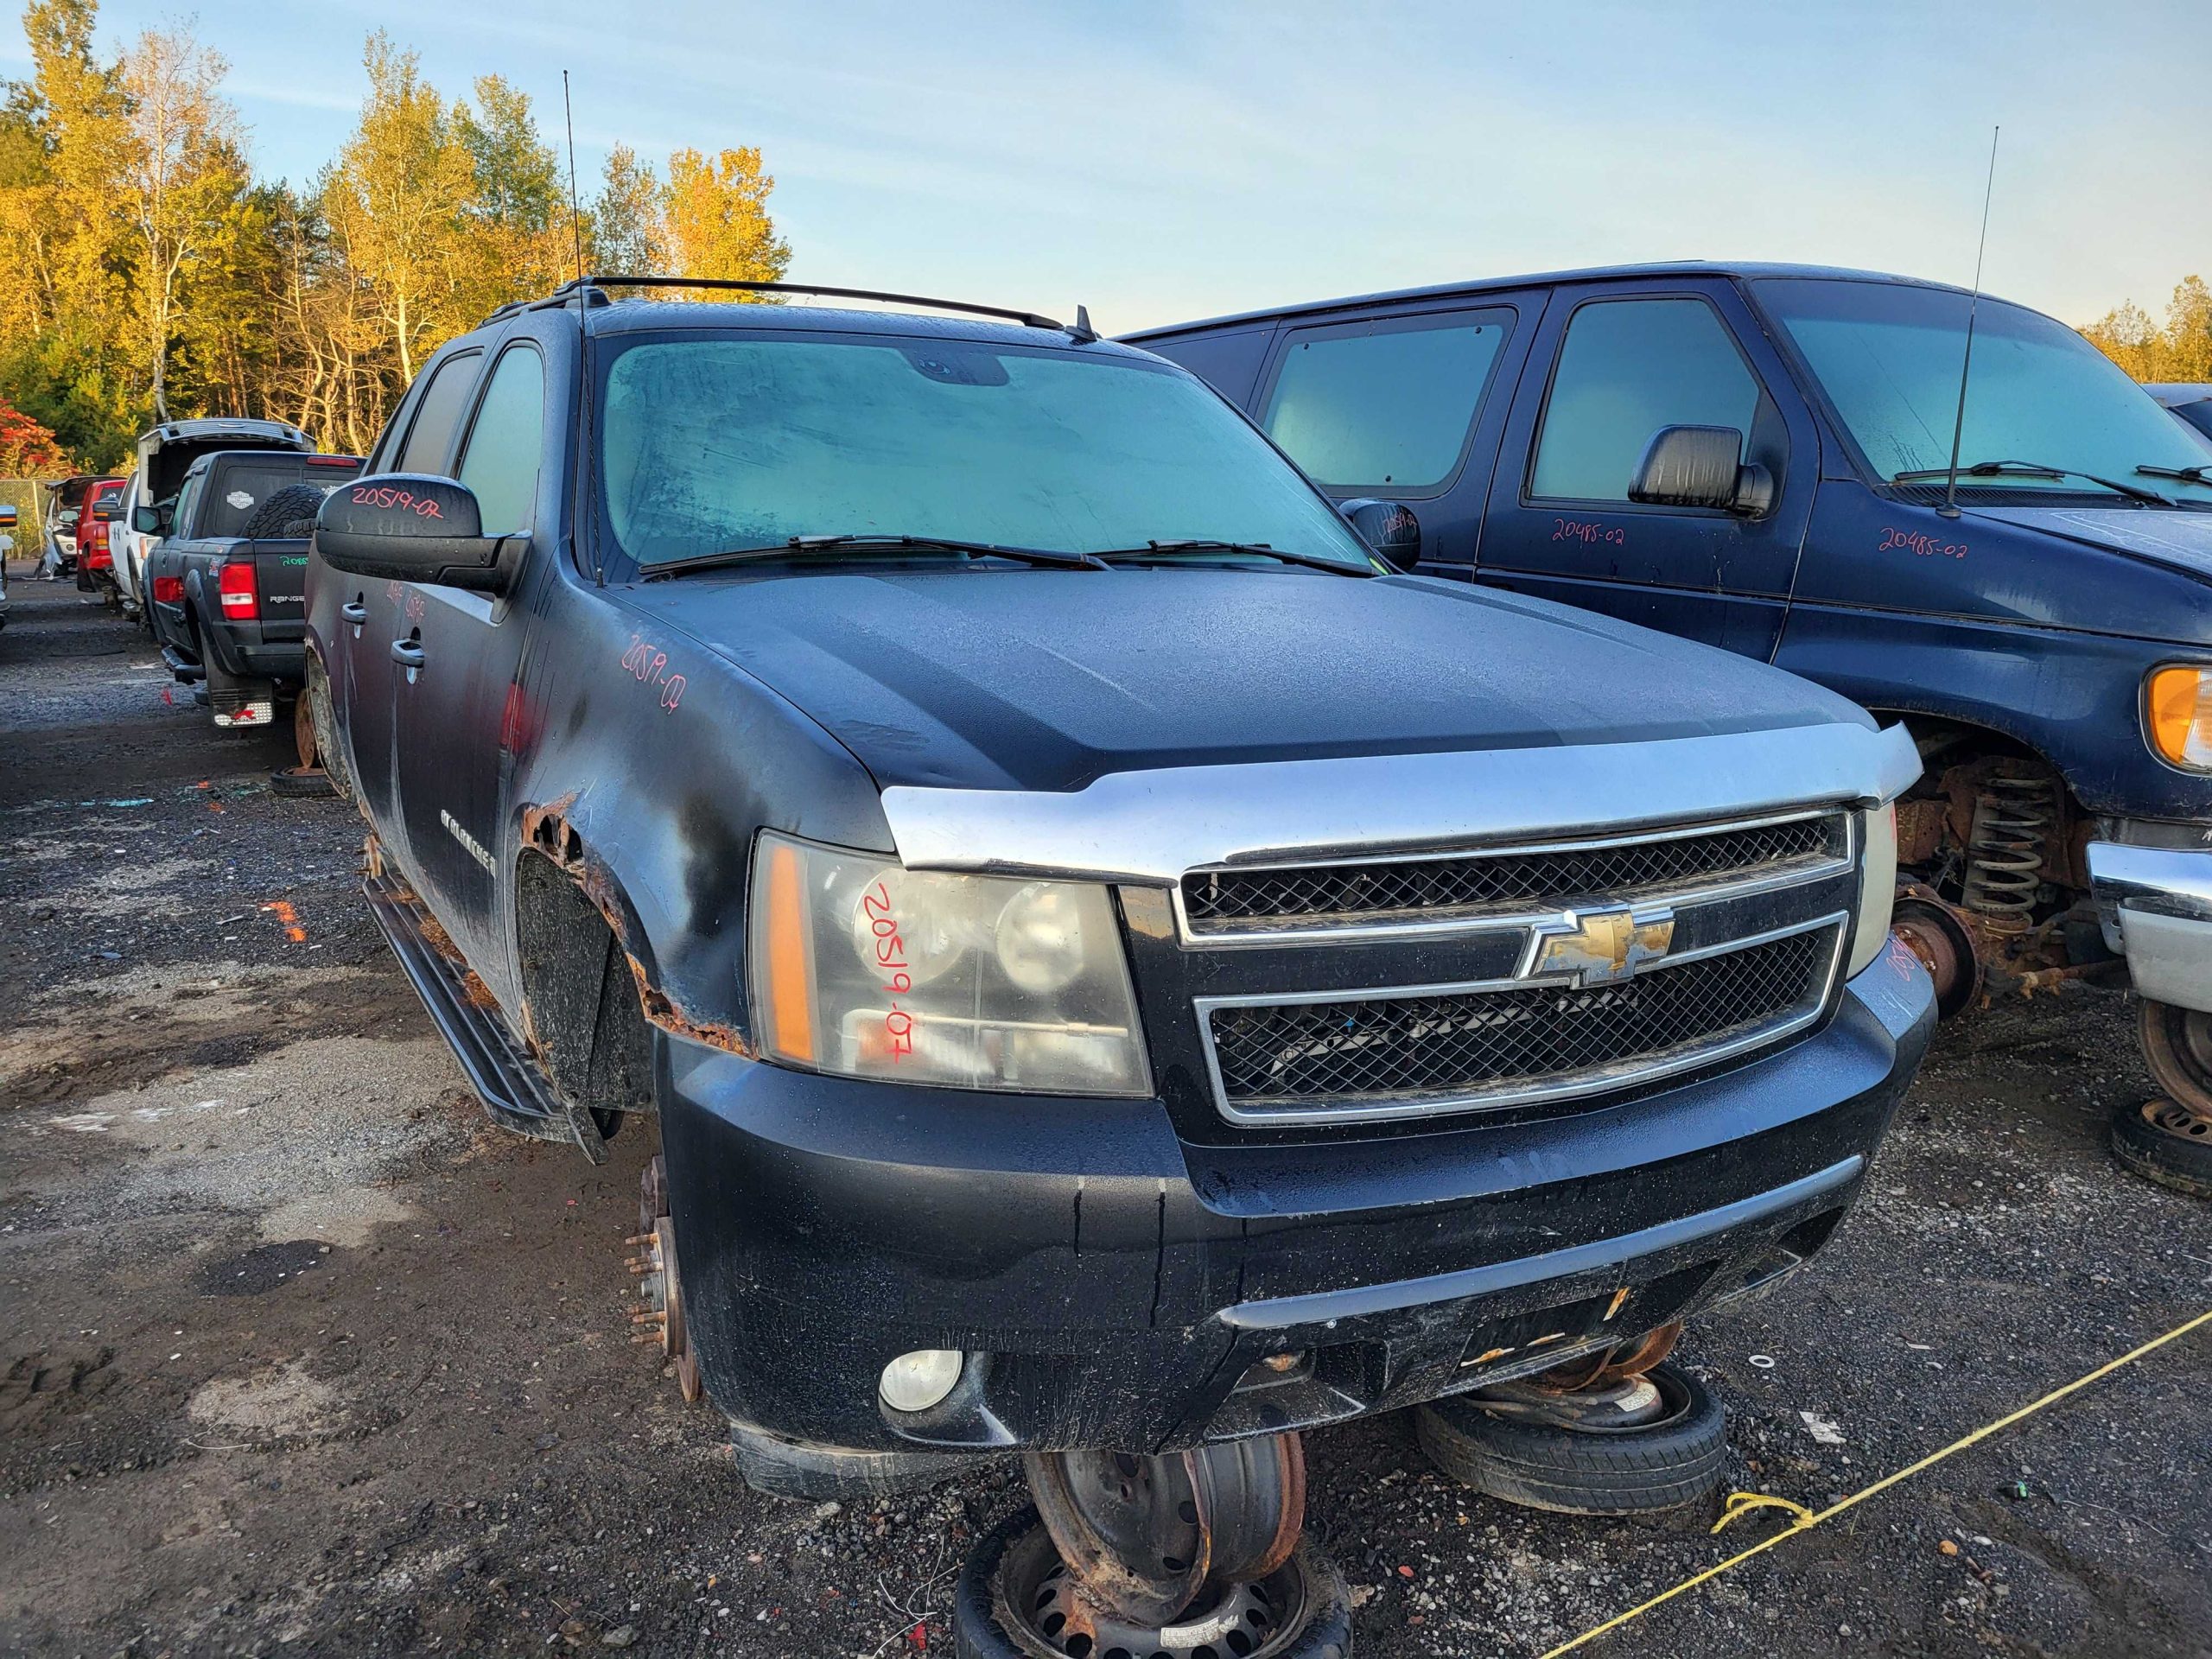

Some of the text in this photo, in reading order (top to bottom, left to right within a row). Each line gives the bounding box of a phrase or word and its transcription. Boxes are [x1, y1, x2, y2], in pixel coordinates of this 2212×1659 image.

[1552, 518, 1624, 544] 20485-02
[1878, 527, 1968, 559] 20485-02
[270, 595, 305, 604] RANGE
